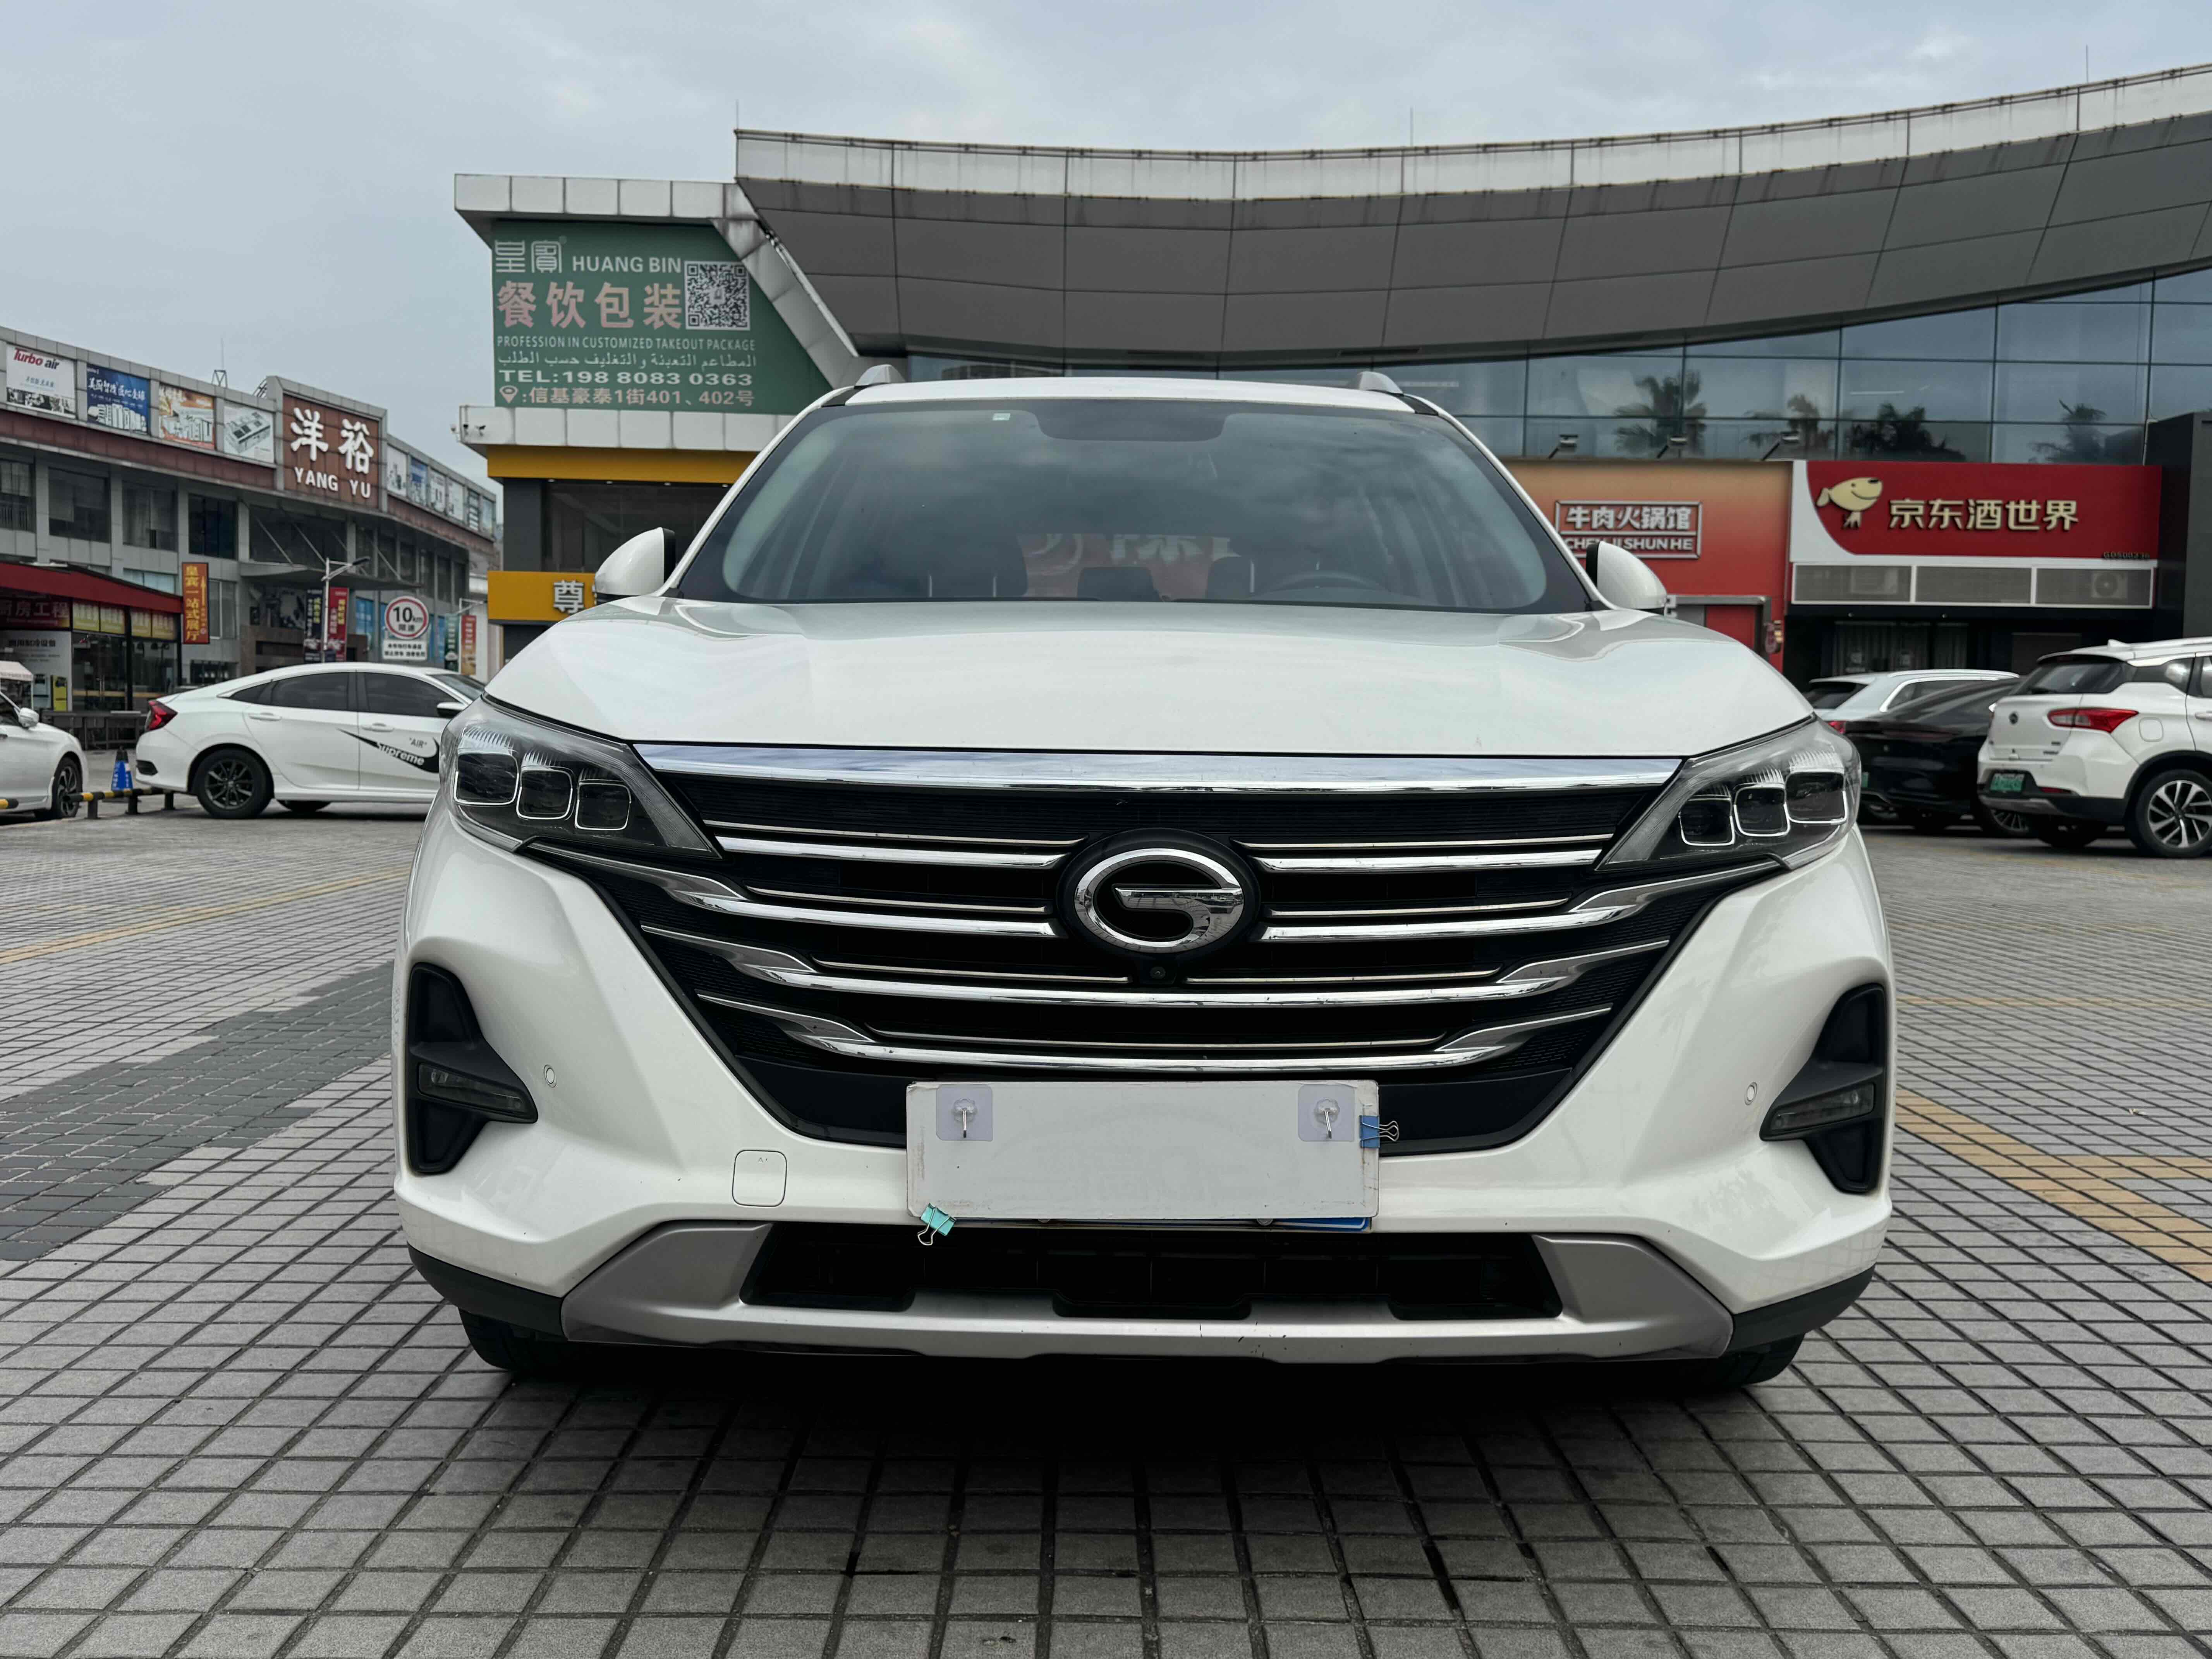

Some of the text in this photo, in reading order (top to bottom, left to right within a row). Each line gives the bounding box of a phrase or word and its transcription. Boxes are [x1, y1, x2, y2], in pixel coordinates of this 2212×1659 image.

[572, 256, 681, 273] HUANG BIN
[497, 280, 682, 329] 餐饮包装
[497, 335, 756, 352] PROFESSION IN CUSTOMIZED TAKEOUT PACKAGE
[14, 347, 59, 369] Turbo air
[617, 371, 681, 385] 8083
[689, 373, 753, 386] 0363
[290, 407, 374, 474] 洋裕
[294, 466, 371, 498] YANG YU
[1566, 505, 1691, 529] 牛肉火锅馆
[1889, 498, 2079, 531] 京东酒世界
[1564, 537, 1606, 549] CHE
[1623, 538, 1667, 550] SHUN
[1670, 539, 1692, 550] HE
